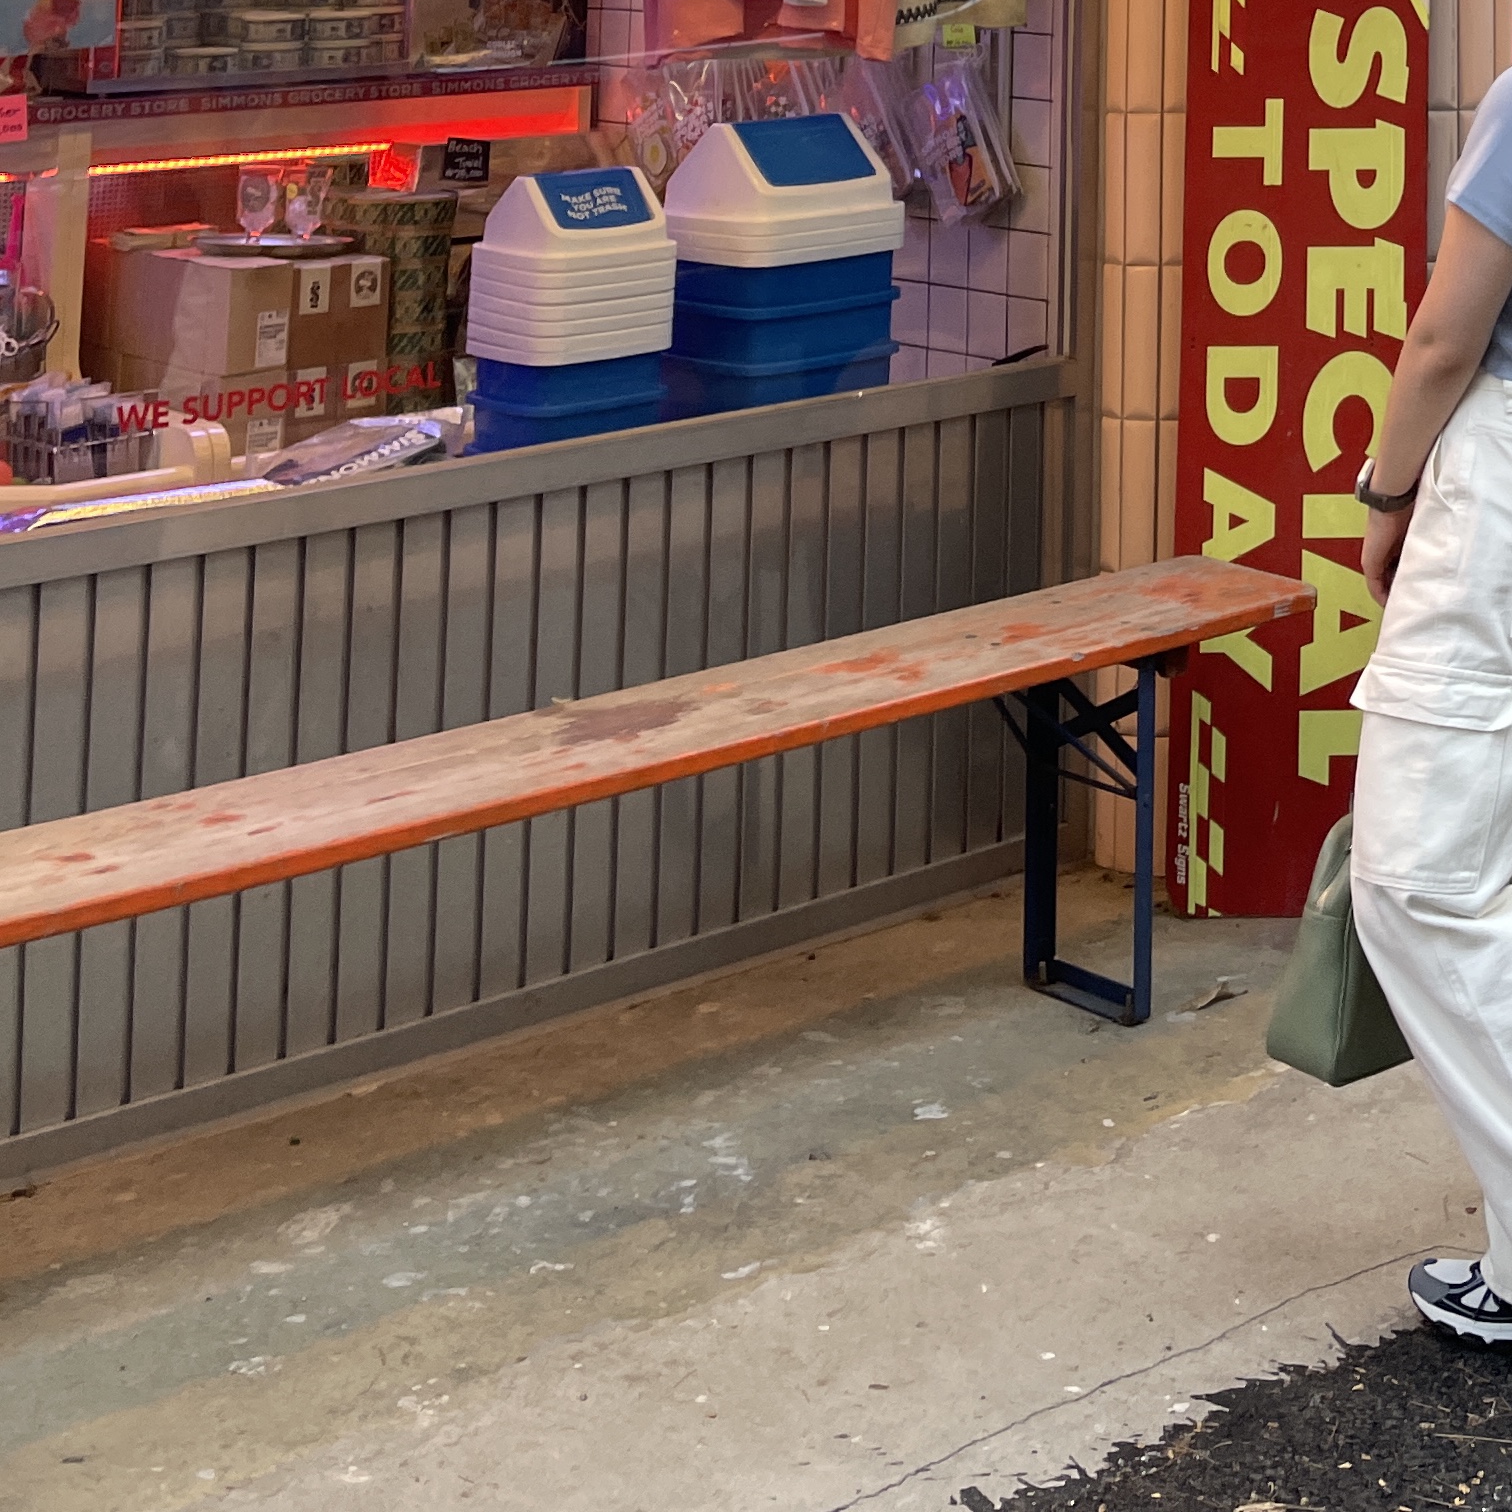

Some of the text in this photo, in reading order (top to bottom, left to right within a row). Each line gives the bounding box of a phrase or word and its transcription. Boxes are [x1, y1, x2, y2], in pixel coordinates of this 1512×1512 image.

[37, 103, 125, 122] GROCERY
[130, 98, 190, 115] STORE
[201, 93, 282, 110] SIMMONS
[288, 86, 366, 104] GROCERY
[370, 83, 422, 98] STORE
[431, 77, 505, 95] SIMMONS
[509, 72, 578, 88] GROCERY
[560, 192, 592, 203] MAKE
[567, 202, 628, 220] NOT TRASH
[572, 194, 616, 211] YOU ARE
[117, 361, 441, 433] WE SUPPORT LOCAL
[1299, 6, 1409, 786] SPECIAL
[1175, 783, 1190, 885] Swartz Signs
